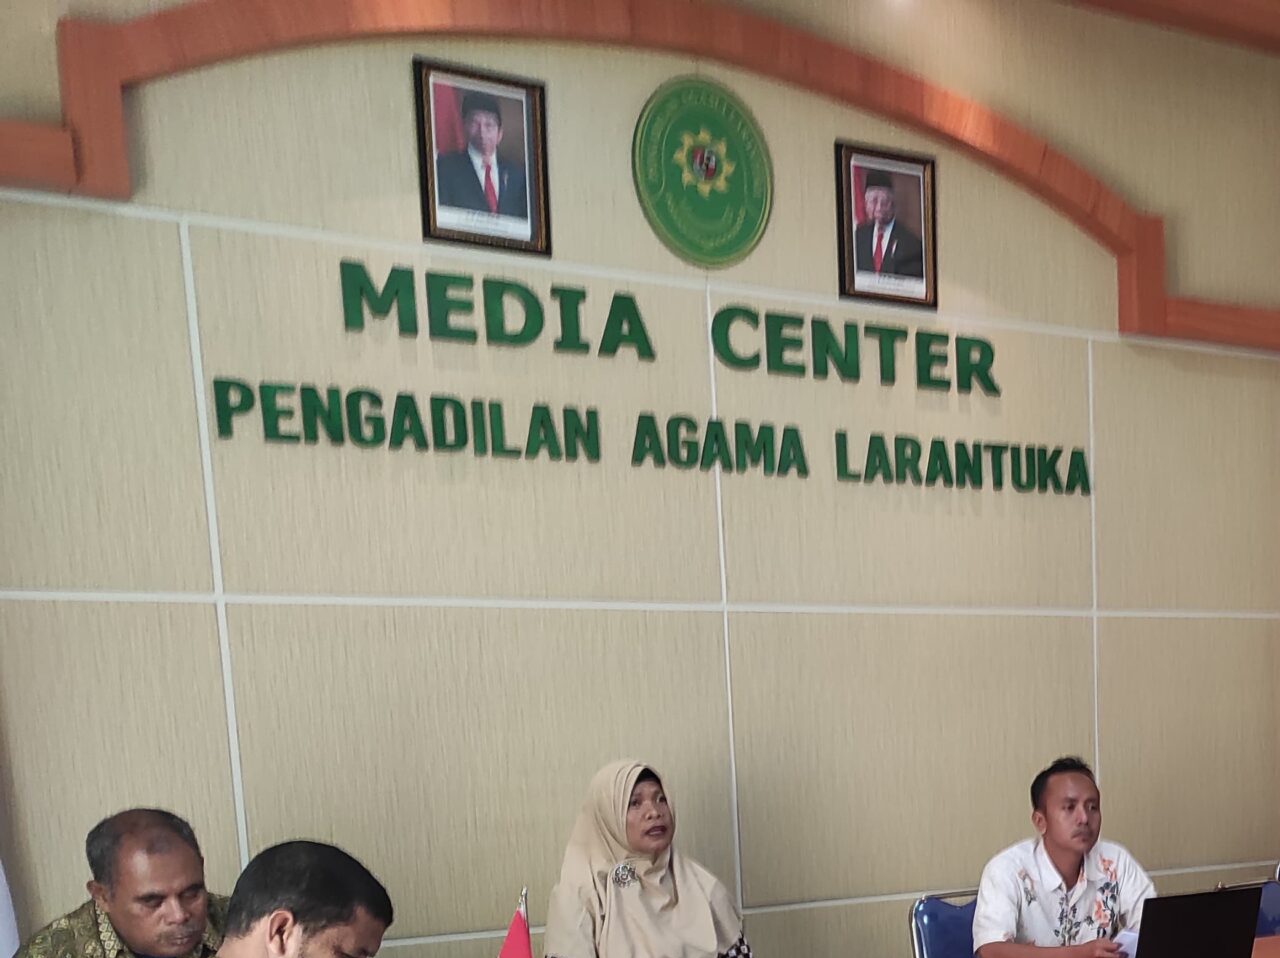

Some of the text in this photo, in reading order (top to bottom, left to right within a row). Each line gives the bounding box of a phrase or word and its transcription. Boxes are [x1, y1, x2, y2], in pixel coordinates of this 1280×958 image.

[341, 261, 999, 396] MEDIA CENTER
[214, 379, 1090, 495] PENGADILAN AGAMA LARANTUKA
